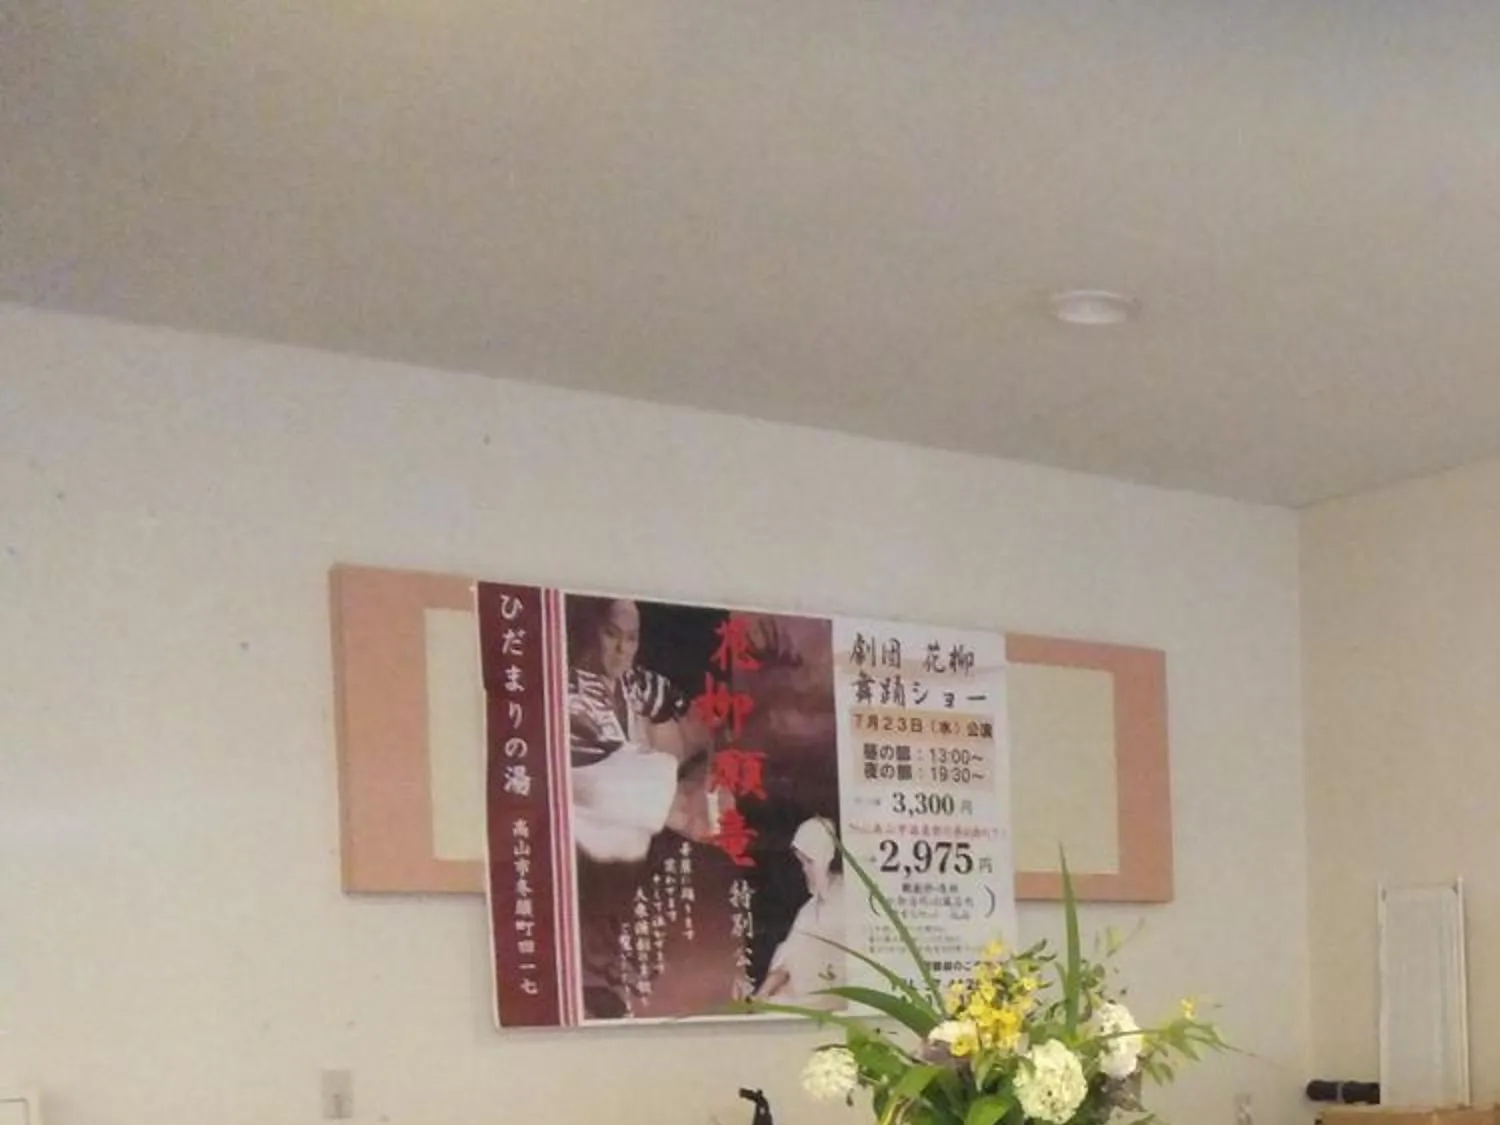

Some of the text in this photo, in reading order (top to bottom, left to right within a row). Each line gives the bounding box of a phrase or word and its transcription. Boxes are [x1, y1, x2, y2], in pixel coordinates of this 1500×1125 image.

[850, 632, 976, 677] 劇団 花柳
[500, 594, 531, 797] ひだまりの湯
[851, 669, 988, 707] 舞踊ショー
